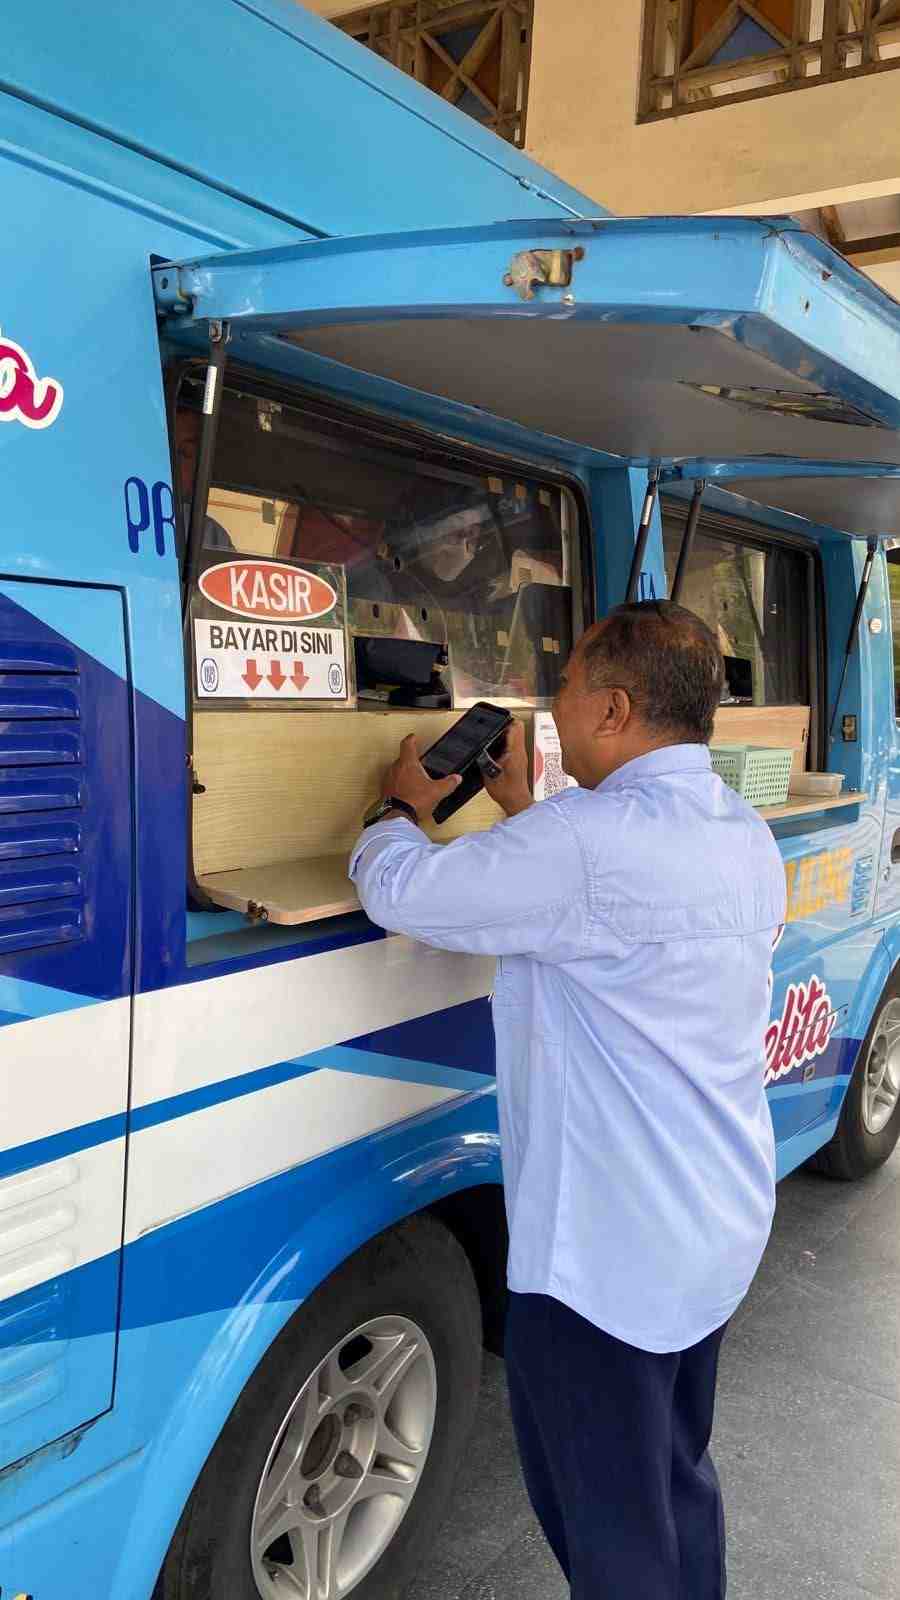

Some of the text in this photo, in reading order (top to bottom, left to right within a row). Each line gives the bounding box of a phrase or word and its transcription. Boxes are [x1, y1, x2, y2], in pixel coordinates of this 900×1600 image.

[230, 566, 312, 614] KASIR
[209, 625, 333, 655] BAYAR DI SINI
